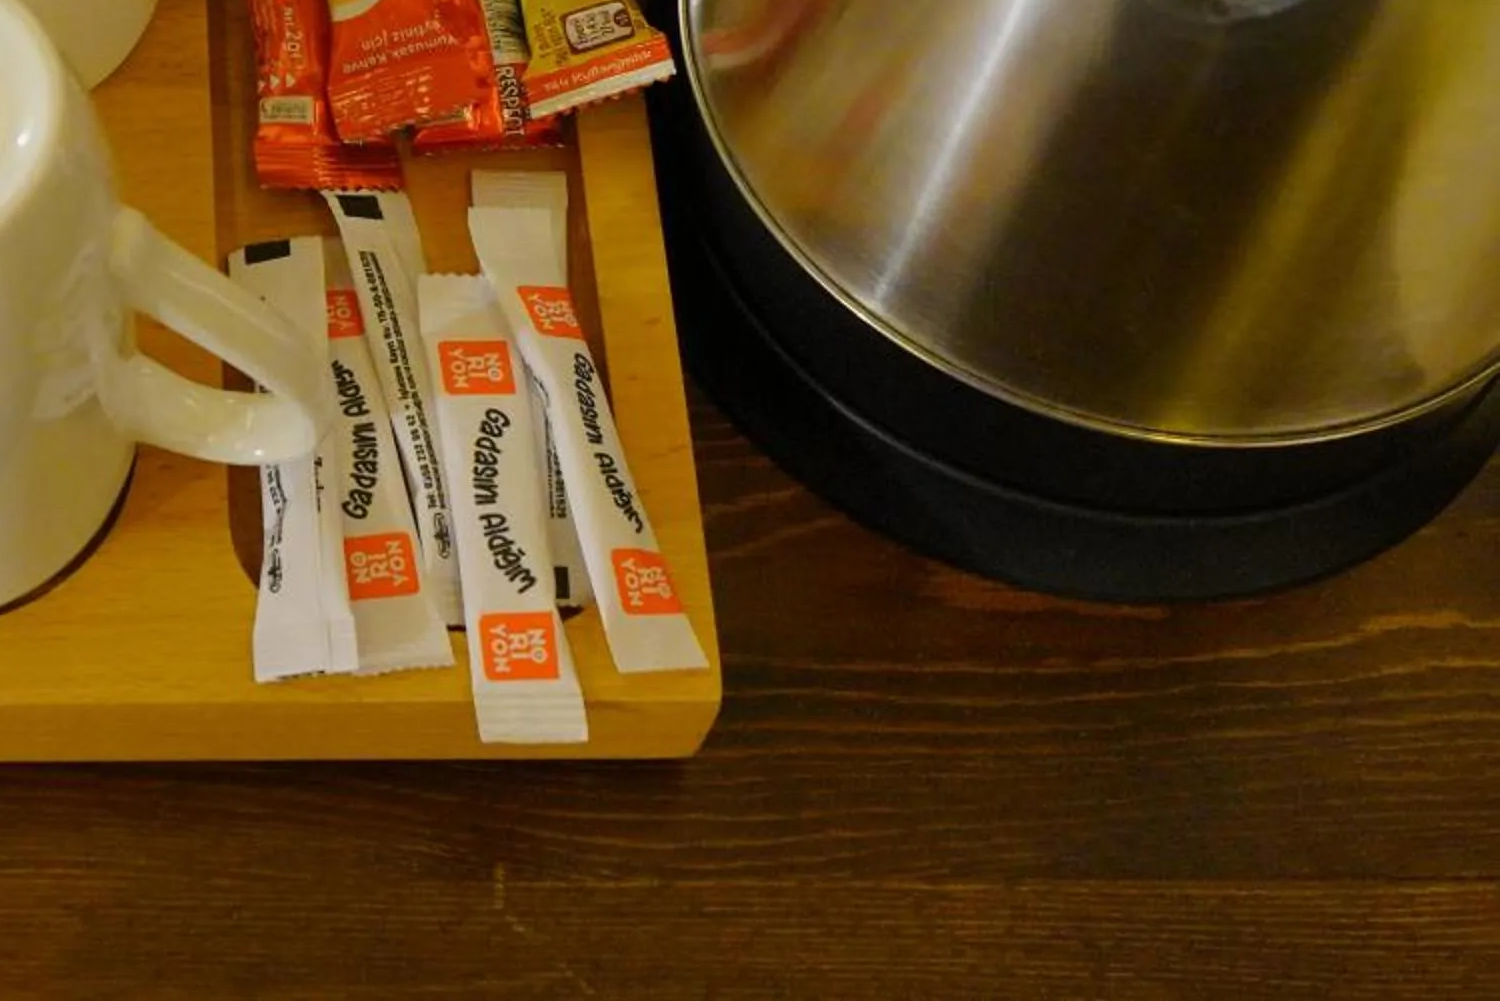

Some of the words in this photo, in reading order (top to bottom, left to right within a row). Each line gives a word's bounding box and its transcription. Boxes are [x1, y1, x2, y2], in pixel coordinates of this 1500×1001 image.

[495, 65, 525, 134] RESPECT
[448, 348, 470, 389] YON
[472, 407, 512, 507] Gadasını
[385, 539, 410, 588] YON
[477, 513, 538, 594] Aldığım
[619, 557, 644, 606] YON
[489, 623, 511, 673] YON
